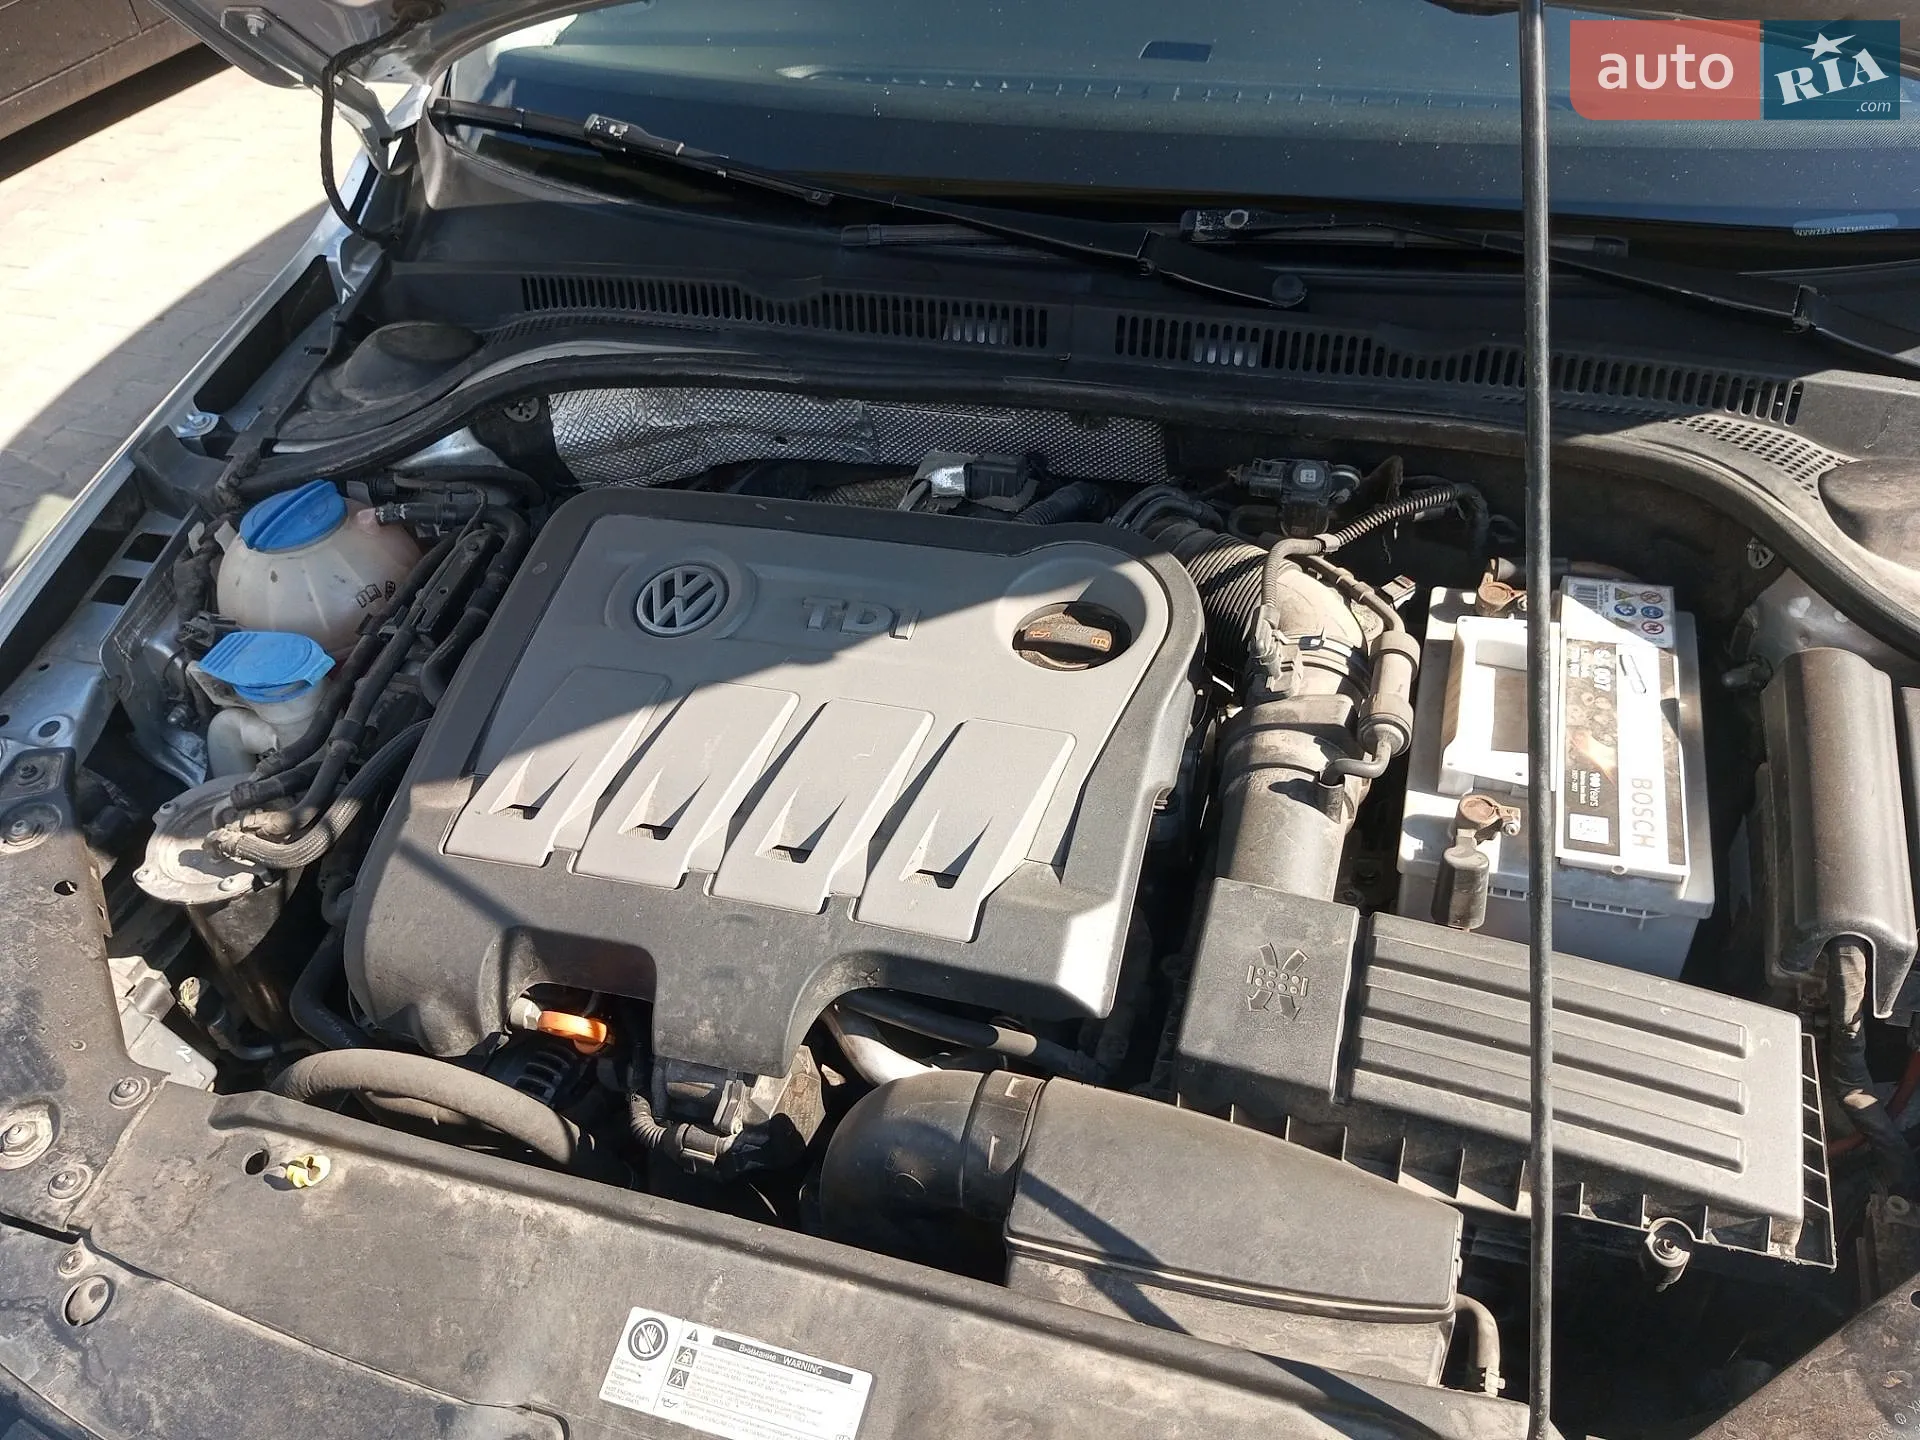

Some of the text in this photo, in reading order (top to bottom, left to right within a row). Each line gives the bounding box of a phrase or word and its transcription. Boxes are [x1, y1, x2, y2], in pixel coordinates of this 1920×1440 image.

[803, 596, 921, 640] TDI
[1631, 777, 1656, 849] BOSCH
[738, 1343, 777, 1362] Внимание
[783, 1355, 823, 1375] WARNING
